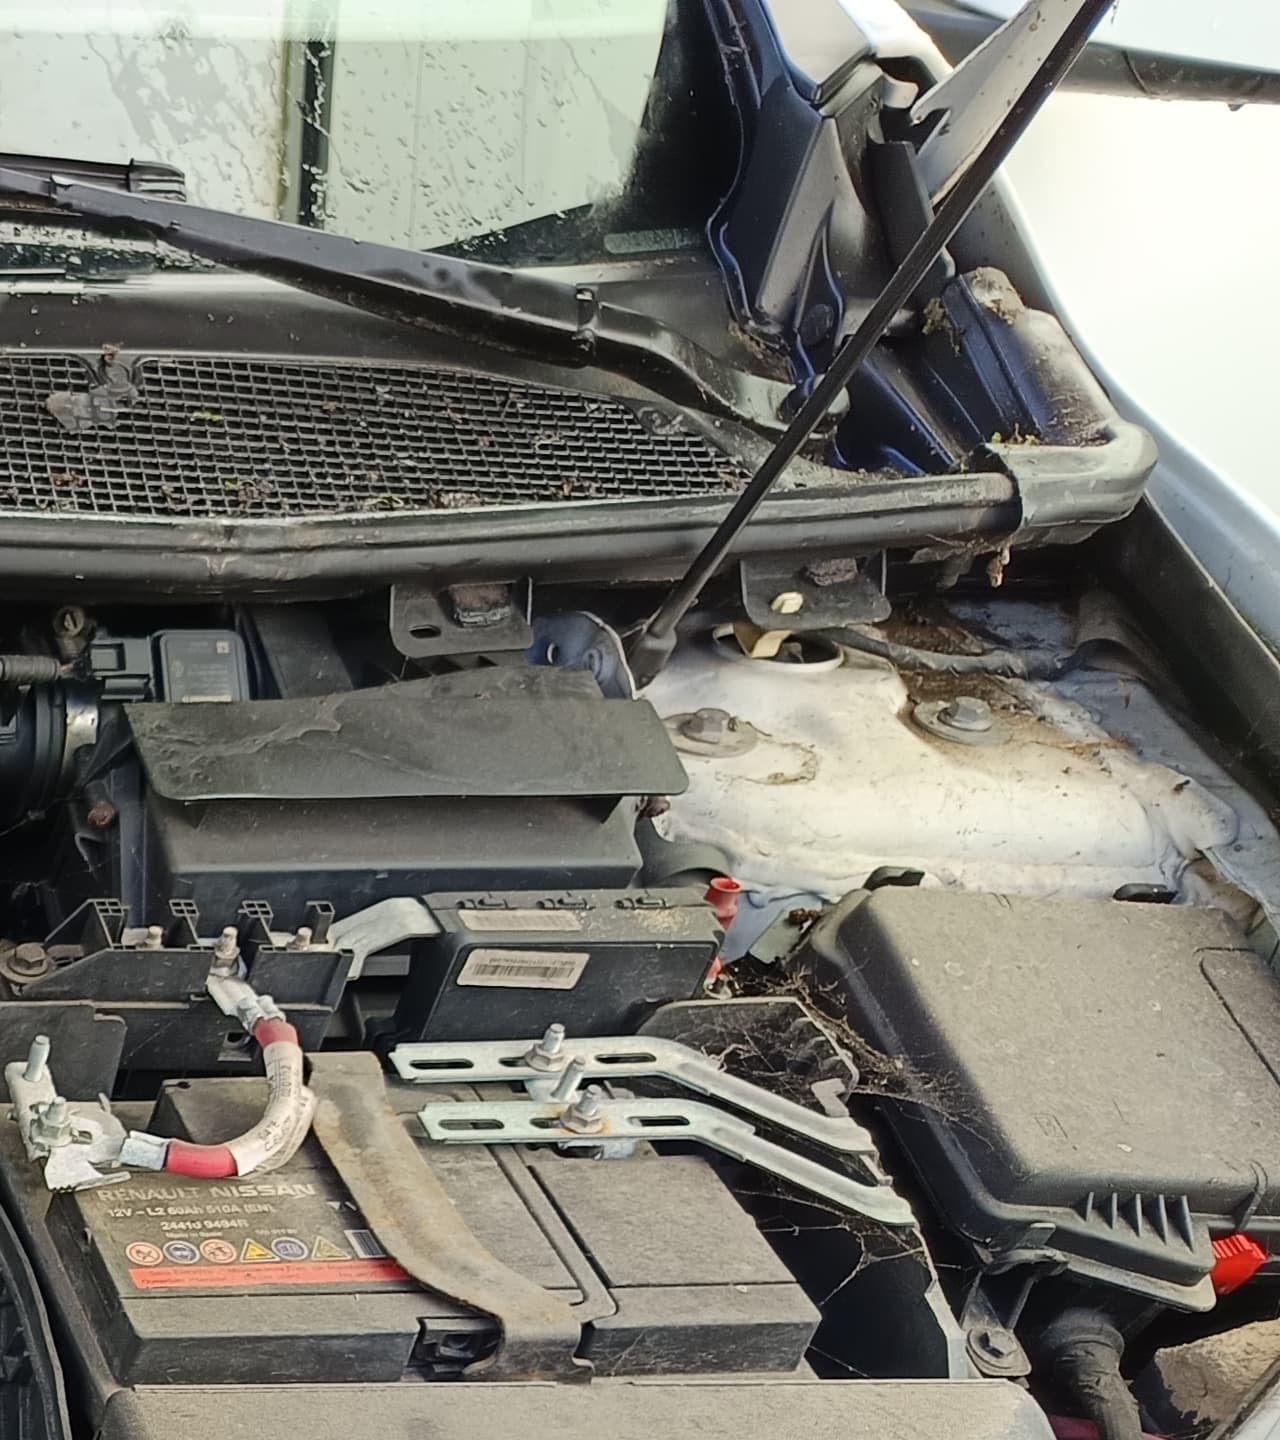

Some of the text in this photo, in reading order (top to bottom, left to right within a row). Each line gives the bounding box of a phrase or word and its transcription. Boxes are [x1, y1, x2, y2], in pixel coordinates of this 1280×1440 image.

[96, 1184, 317, 1202] RENAULT NISSAN
[106, 1208, 132, 1218] 12V
[146, 1207, 167, 1217] L2
